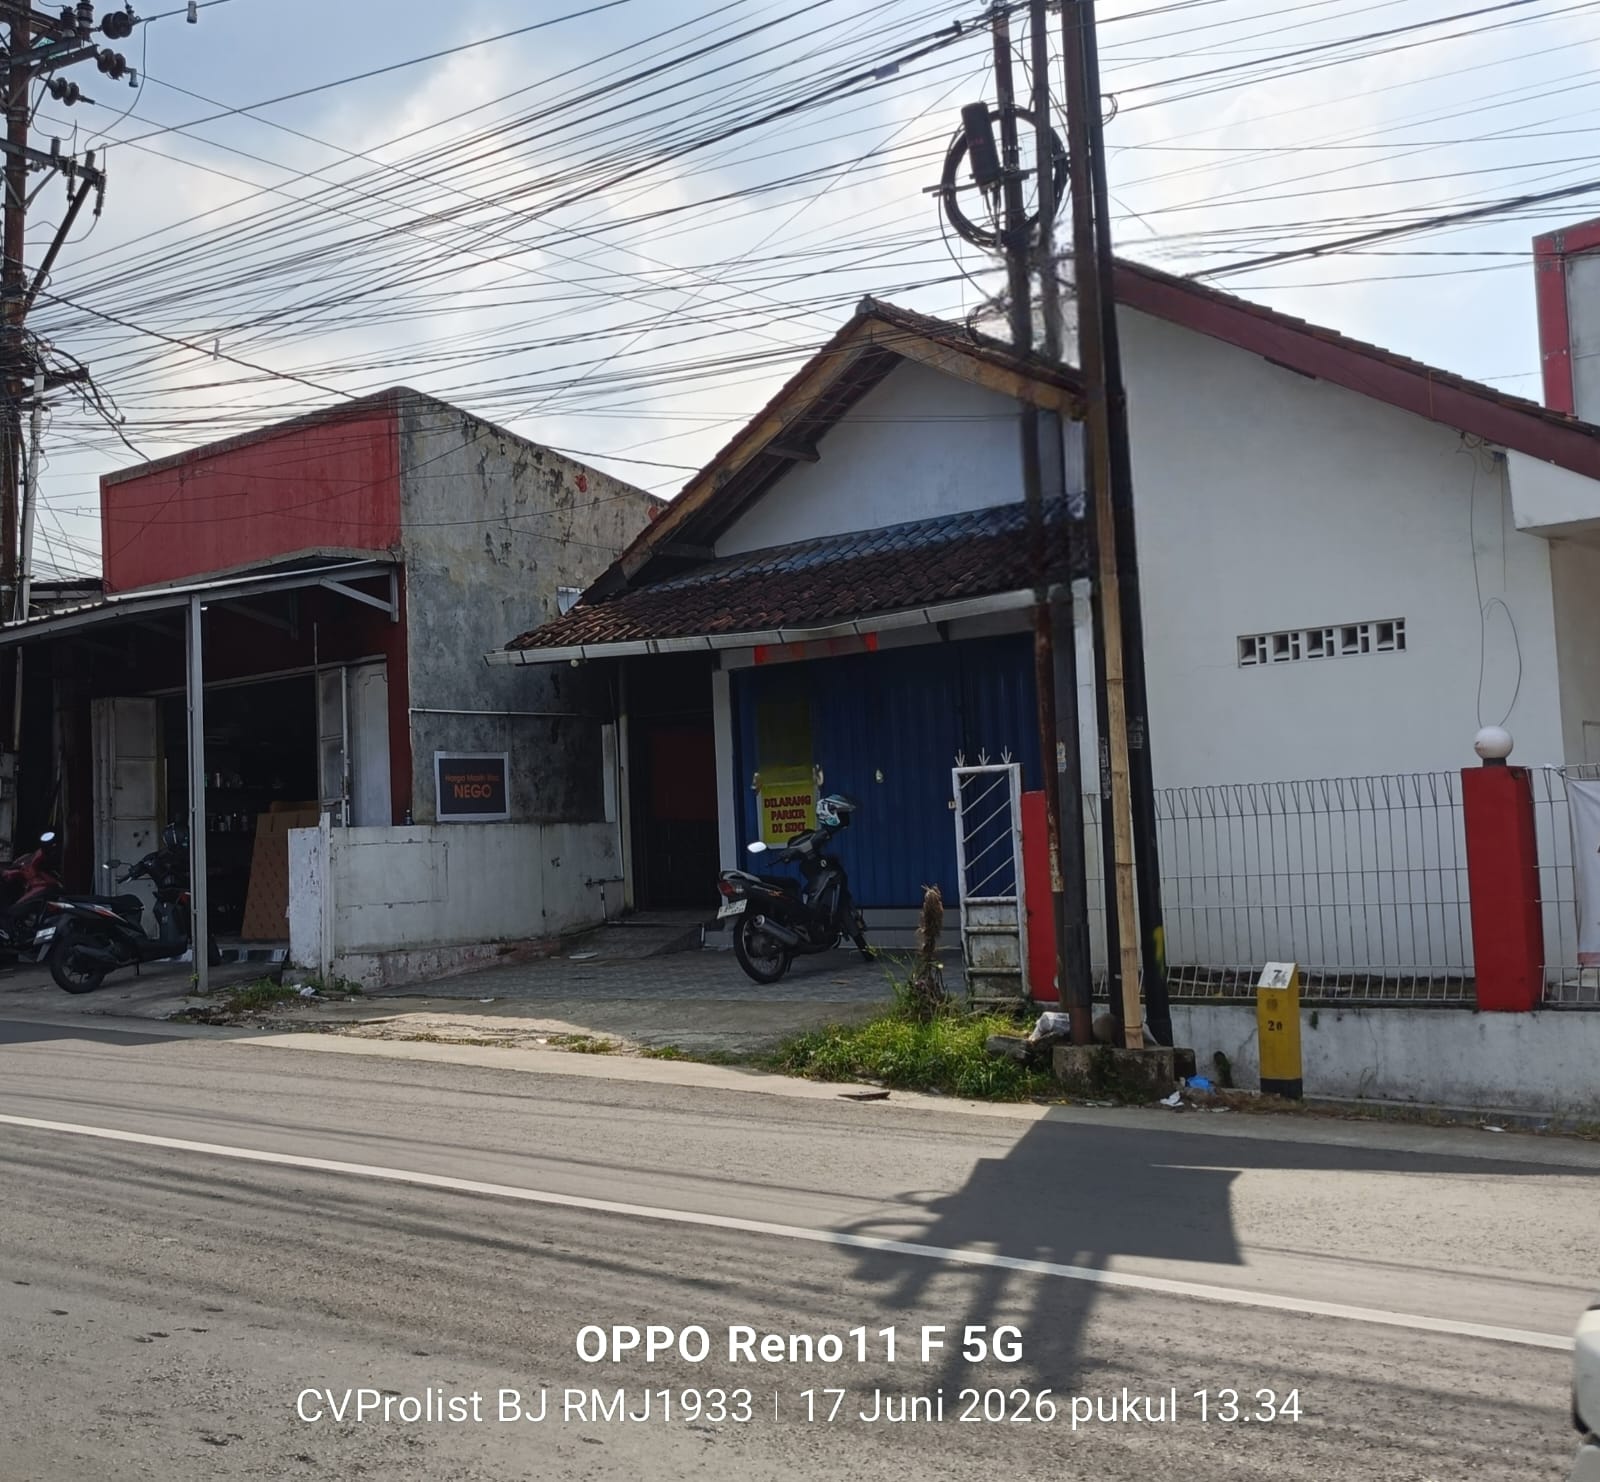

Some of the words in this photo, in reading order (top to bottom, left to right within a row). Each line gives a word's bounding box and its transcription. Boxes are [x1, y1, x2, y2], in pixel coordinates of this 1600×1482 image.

[454, 784, 492, 799] NEGO
[764, 795, 811, 808] DILARANG
[771, 809, 806, 821] PARKIR
[772, 823, 783, 833] DI
[785, 822, 806, 833] SINI
